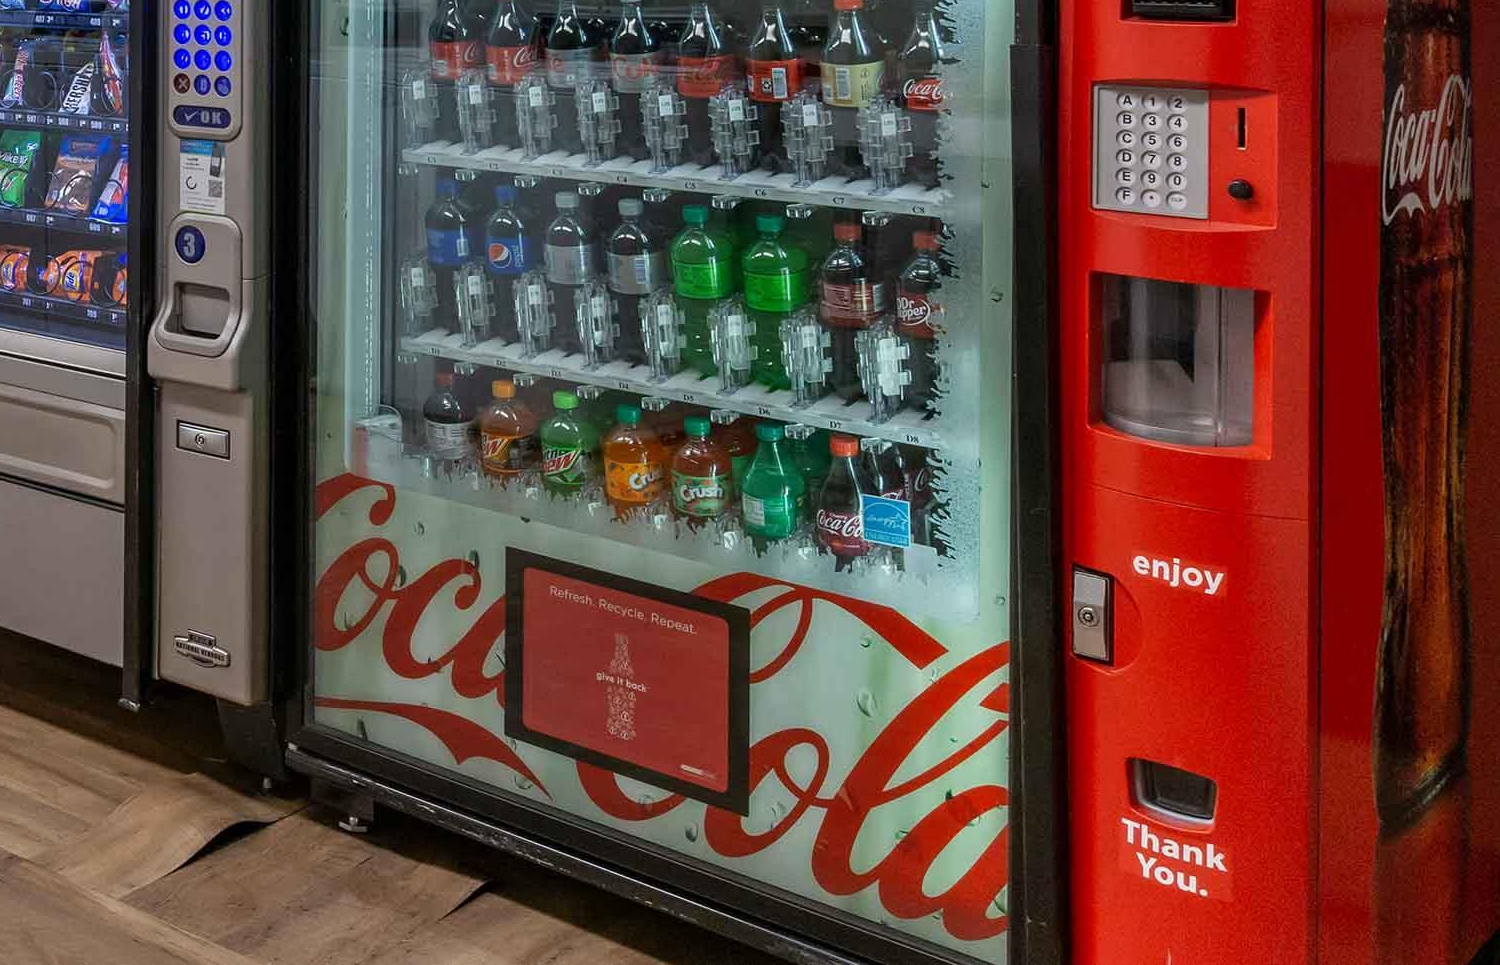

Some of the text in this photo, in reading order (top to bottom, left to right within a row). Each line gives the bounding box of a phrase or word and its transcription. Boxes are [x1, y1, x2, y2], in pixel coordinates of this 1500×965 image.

[1123, 95, 1132, 106] A
[1150, 97, 1155, 107] 1
[1174, 98, 1182, 109] 2
[200, 111, 222, 125] OK
[1123, 114, 1132, 124] B
[1148, 116, 1156, 126] 3
[1173, 117, 1182, 128] 4
[1122, 133, 1132, 144] C
[1148, 135, 1156, 145] 5
[1174, 137, 1182, 147] 6
[1122, 153, 1132, 162] D
[1149, 154, 1156, 164] 7
[1174, 156, 1182, 166] 8
[1122, 171, 1131, 181] E
[1148, 173, 1156, 184] 9
[1173, 175, 1181, 186] 0
[685, 182, 696, 190] C5
[832, 196, 845, 204] C7
[1122, 190, 1130, 200] F
[912, 205, 925, 214] C8
[183, 232, 196, 258] 3
[66, 271, 77, 291] Tide
[496, 359, 507, 367] D2
[683, 393, 695, 402] D5
[758, 407, 771, 415] D6
[829, 421, 842, 429] D7
[906, 434, 920, 444] D8
[679, 486, 723, 502] Crush
[816, 509, 864, 537] Coca-Co
[1132, 554, 1224, 595] enjoy
[651, 612, 698, 635] Repeat.
[596, 670, 647, 693] give it back
[1121, 817, 1228, 873] Thank
[1135, 852, 1208, 897] You.
